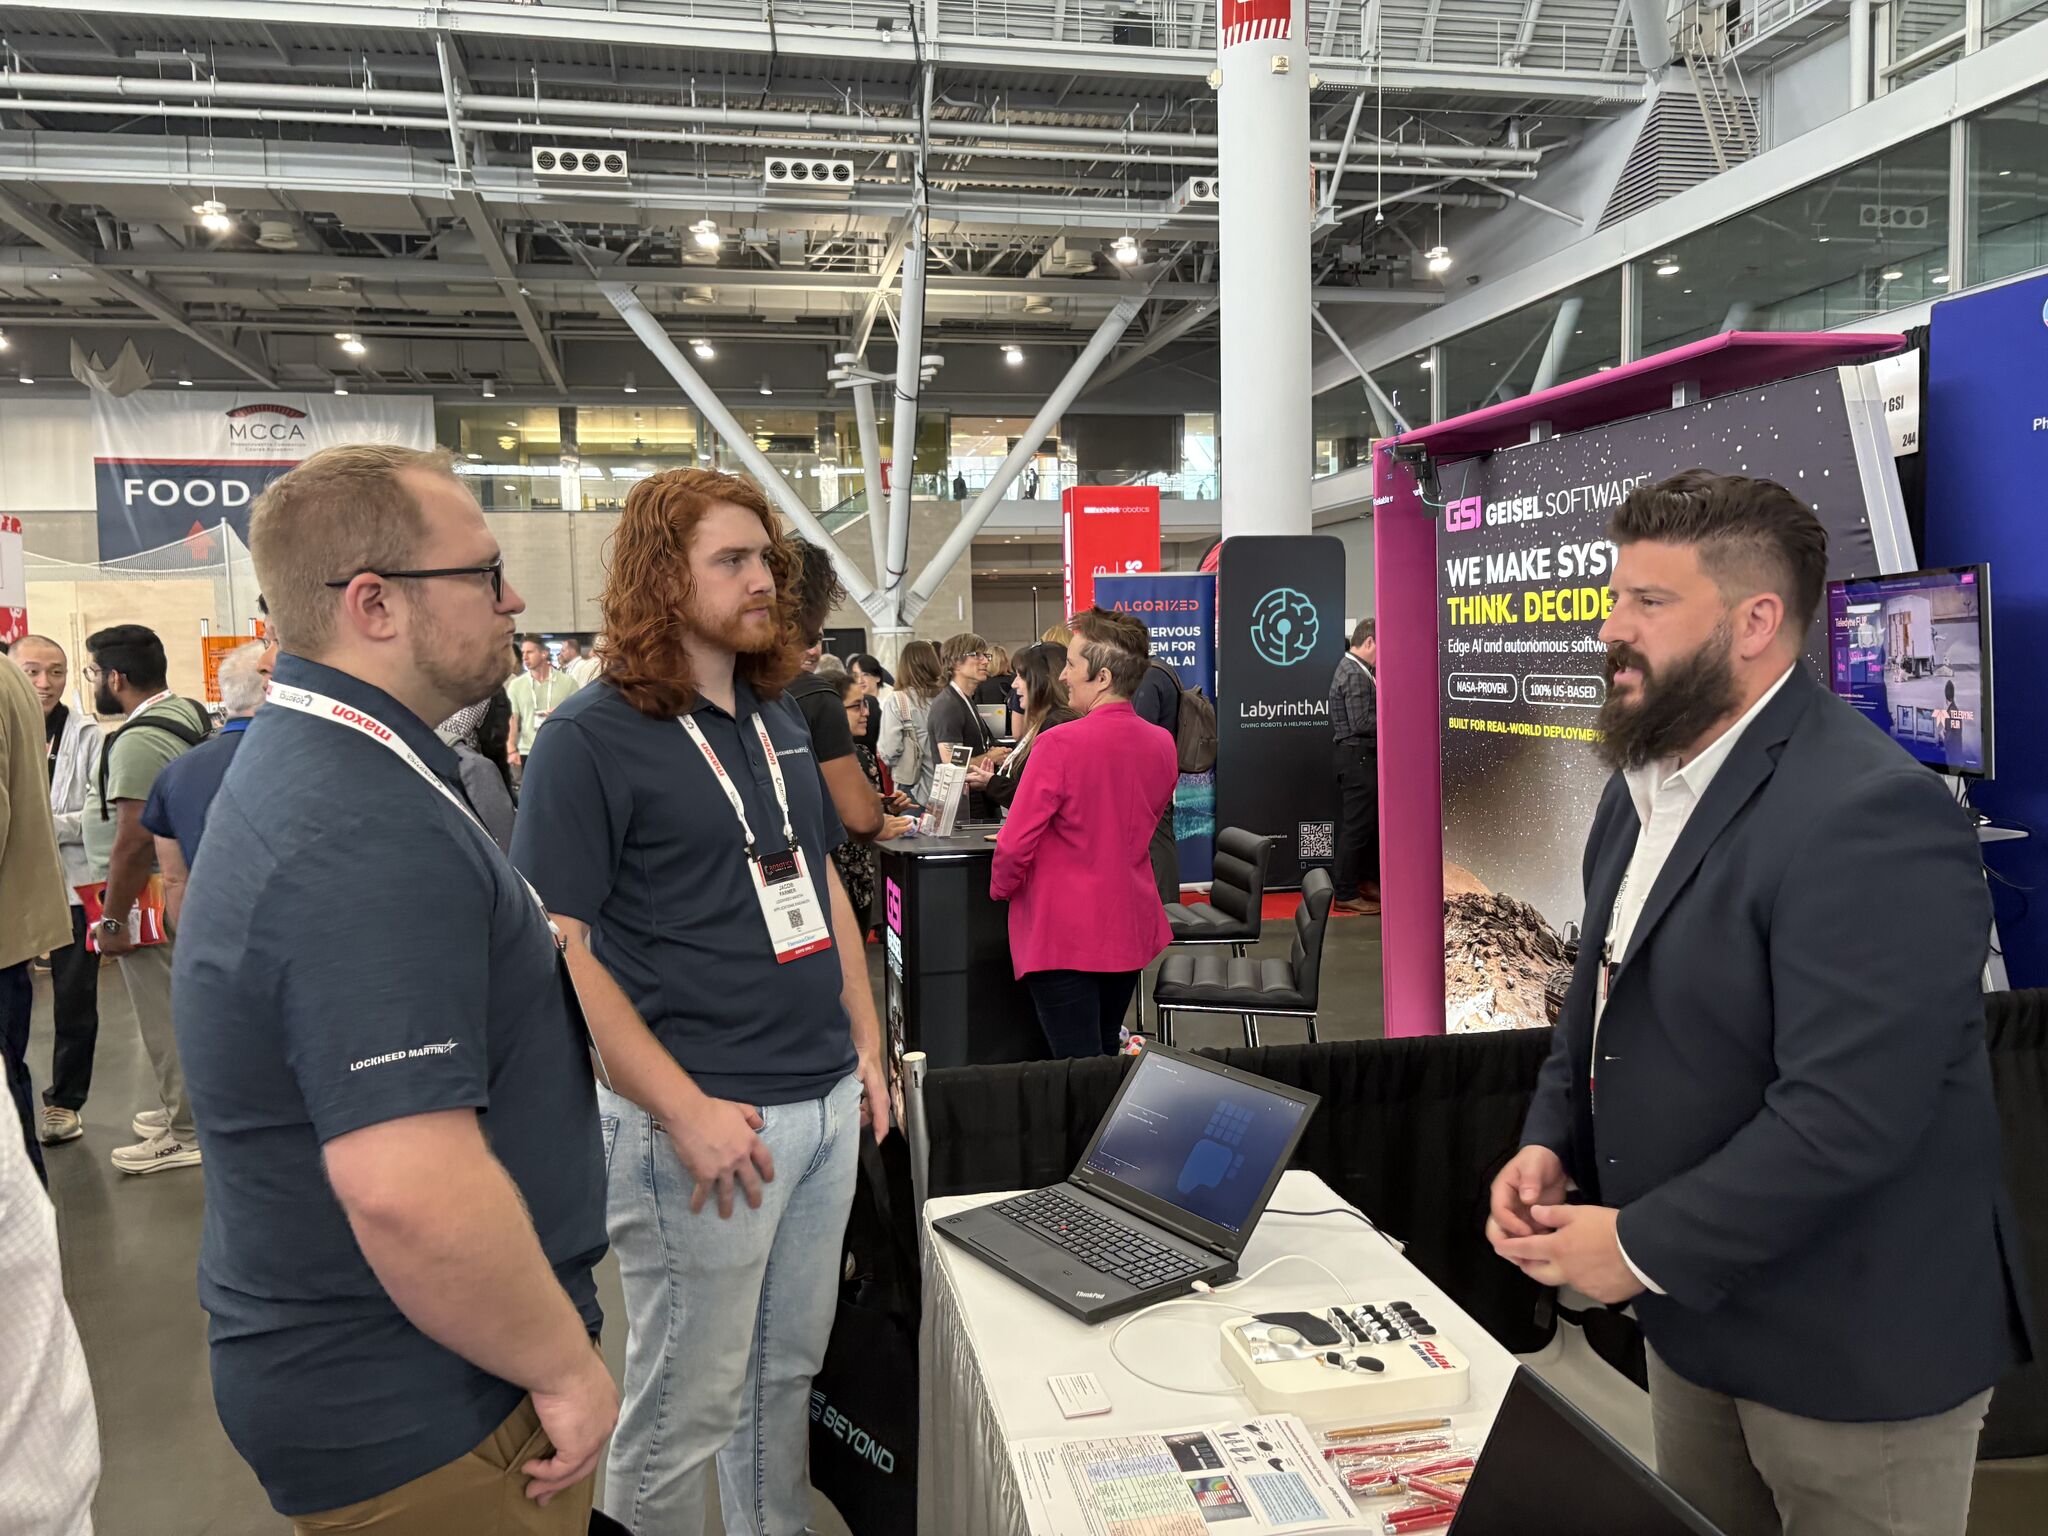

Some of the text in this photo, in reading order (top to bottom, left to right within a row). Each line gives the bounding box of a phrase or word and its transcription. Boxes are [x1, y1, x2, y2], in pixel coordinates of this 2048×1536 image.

[1888, 395, 1904, 412] GSI
[229, 423, 305, 440] MCCA
[1902, 432, 1916, 447] 244
[123, 479, 250, 507] FOOD
[1446, 496, 1482, 533] GSI
[1486, 496, 1543, 526] GEISEL
[1446, 555, 1483, 587] WE
[1486, 548, 1551, 584] MAKE
[1113, 600, 1199, 612] ALGORIZED
[1447, 592, 1518, 625] THINK.
[1171, 641, 1196, 651] FOR
[1448, 639, 1470, 657] Edge
[1472, 639, 1483, 652] AI
[1484, 638, 1502, 653] and
[1504, 641, 1569, 653] autonomous
[1184, 656, 1195, 666] AI
[1457, 681, 1507, 694] NASA-PROVEN
[1530, 684, 1597, 698] 100% US-BASED
[1240, 699, 1329, 720] LabyrinthAI
[332, 705, 392, 741] maxon
[1449, 717, 1469, 730] BUILT
[1470, 719, 1486, 732] FOR
[1487, 720, 1542, 737] REAL-WORLD
[759, 731, 777, 766] maxon
[700, 742, 725, 777] maxon
[350, 1046, 444, 1071] LOCKHEED MARTIN
[155, 1143, 183, 1158] HOKA
[1076, 1291, 1105, 1299] ThinkPad
[823, 1405, 895, 1473] BEYOND
